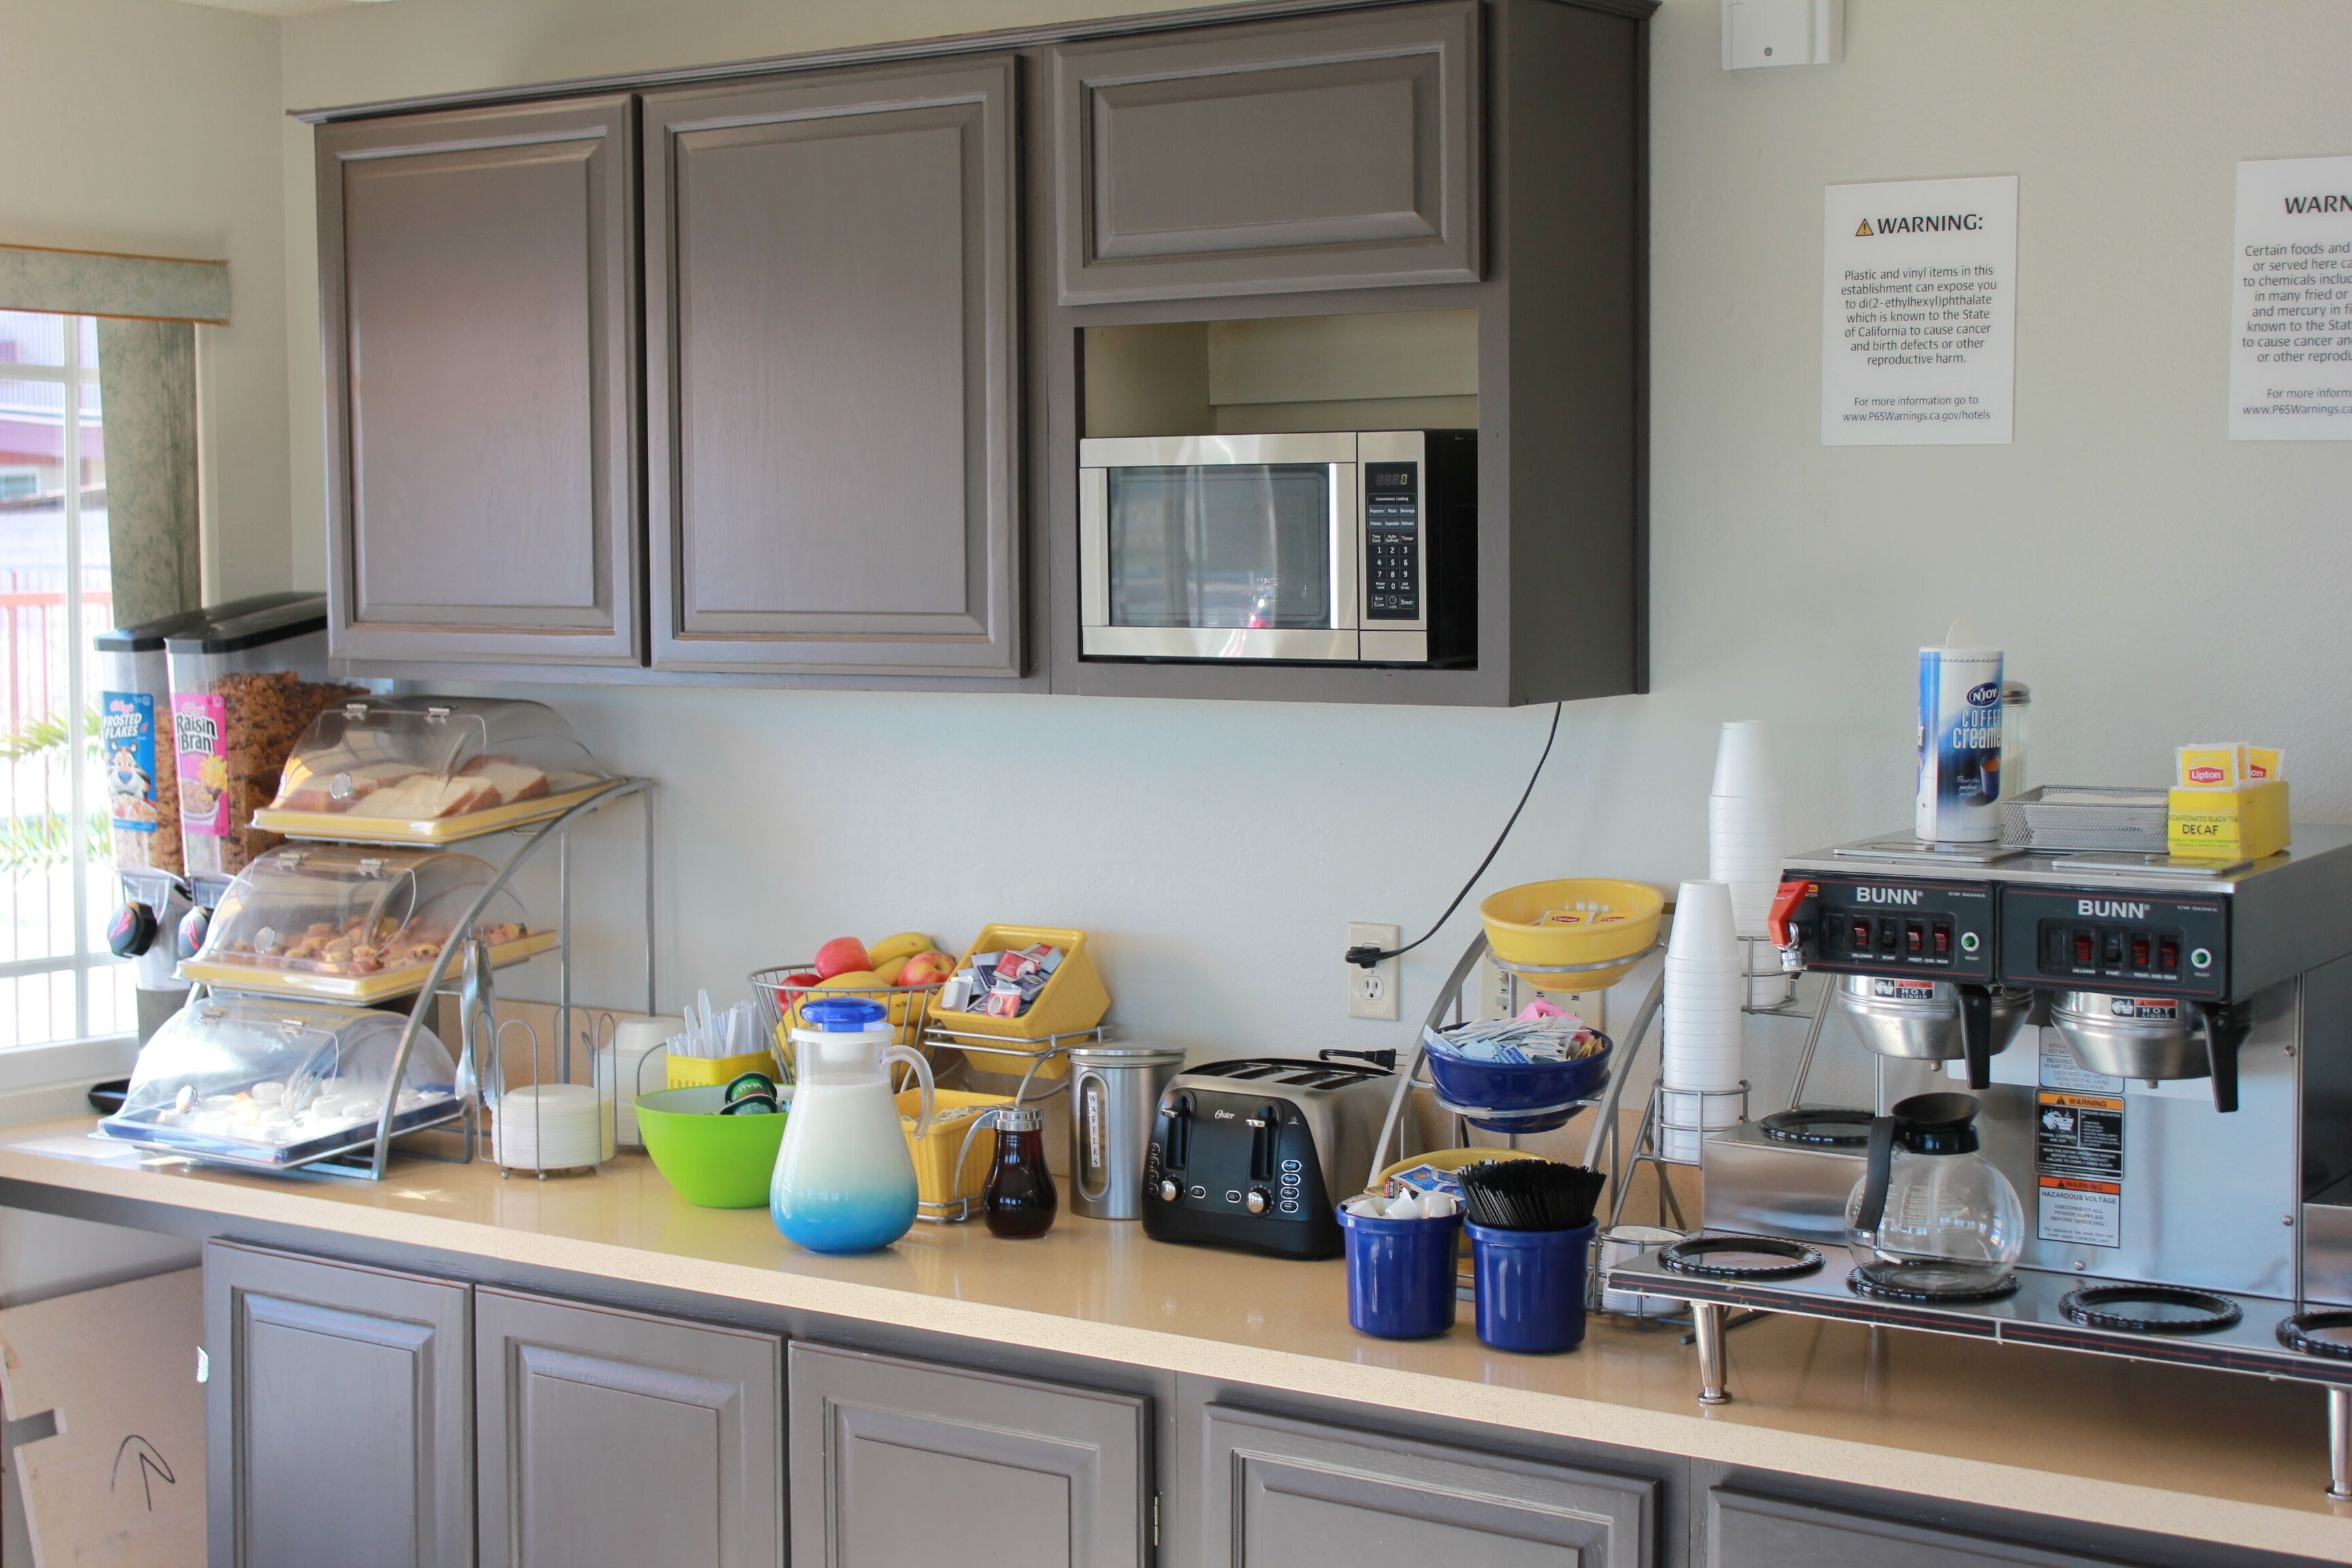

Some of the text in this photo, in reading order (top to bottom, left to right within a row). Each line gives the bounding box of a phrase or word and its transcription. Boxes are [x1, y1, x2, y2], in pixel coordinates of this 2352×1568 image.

[1877, 214, 1983, 234] WARNING:
[2245, 243, 2350, 256] Certain foods and
[2253, 262, 2265, 271] or
[2269, 259, 2307, 271] served
[2311, 259, 2336, 269] here
[1845, 265, 1993, 280] Plastic and vinyl items in this
[2243, 277, 2255, 287] to
[2259, 274, 2315, 286] chemicals
[1841, 281, 1997, 296] establishment can expose you
[2255, 289, 2348, 303] in many fried or
[1845, 299, 1856, 309] to
[2252, 306, 2273, 317] and
[2277, 307, 2326, 317] mercury
[2330, 304, 2340, 315] in
[1847, 309, 1990, 323] which is known to the State
[1845, 324, 1991, 337] of California to cause cancer
[2247, 321, 2286, 332] known
[2290, 322, 2302, 331] to
[2306, 320, 2324, 331] the
[1850, 338, 1985, 351] and birth defects or other
[2243, 338, 2254, 347] to
[2257, 339, 2290, 347] cause
[2294, 338, 2332, 346] cancer
[1867, 353, 1966, 367] reproductive harm.
[2257, 354, 2269, 362] or
[2273, 351, 2304, 362] other
[2267, 389, 2283, 398] For
[2287, 389, 2314, 398] more
[1854, 395, 1979, 407] For more information go to
[1842, 410, 1991, 422] www.P65Warnings.ca.gov/hotels
[103, 713, 142, 727] FROSTED
[176, 714, 216, 737] Raisin
[105, 726, 138, 739] FLAKES
[180, 733, 212, 753] Bran
[2191, 770, 2221, 780] Lipton
[2183, 824, 2218, 835] DECAF
[2069, 1098, 2107, 1107] WARNING
[1214, 1109, 1235, 1119] Oster
[1089, 1095, 1098, 1165] WAFFLES
[2066, 1182, 2103, 1190] WARNING
[2042, 1191, 2117, 1204] HAZARDOUS VOLTAGE
